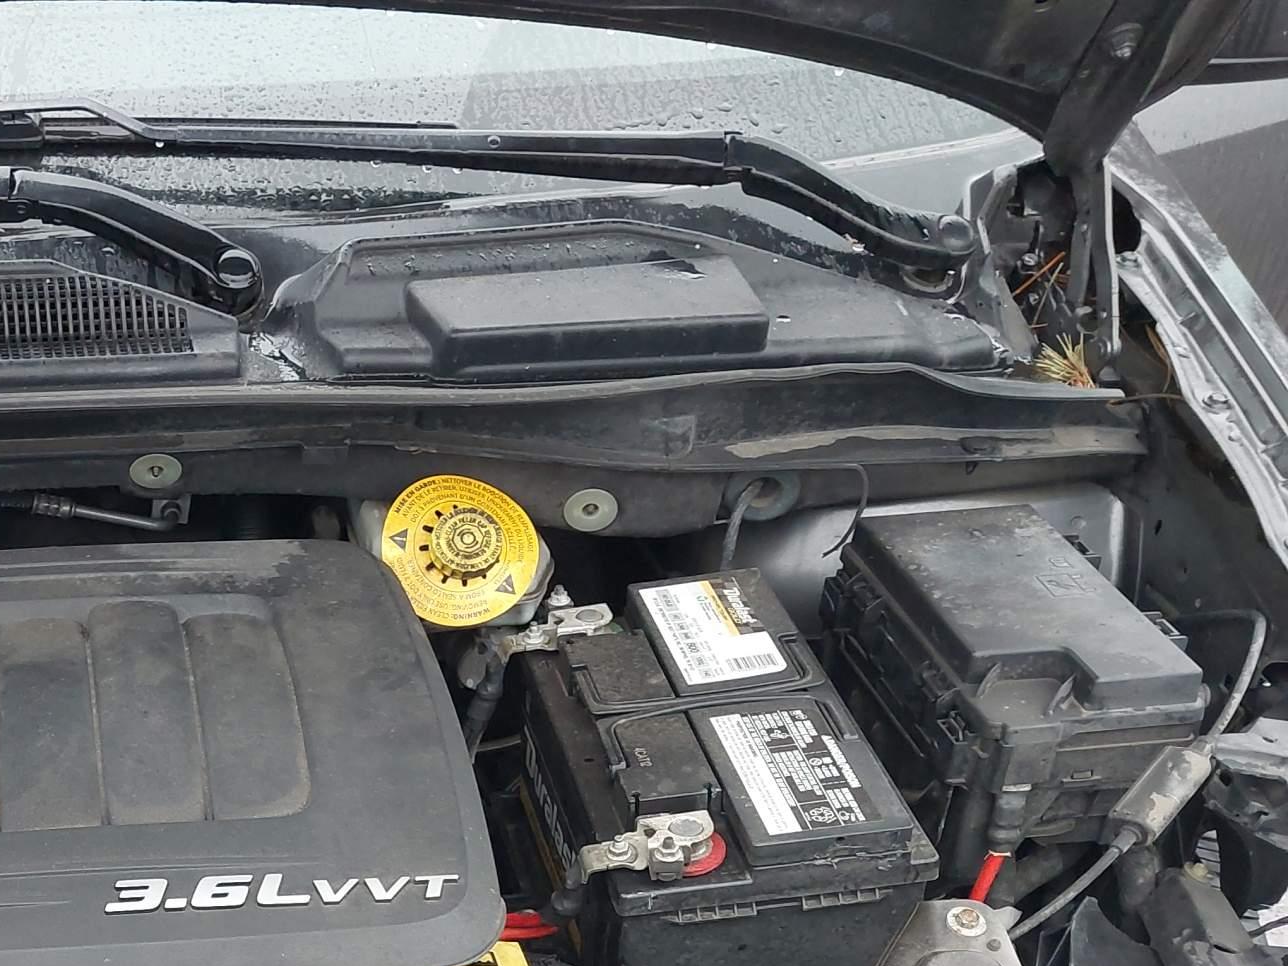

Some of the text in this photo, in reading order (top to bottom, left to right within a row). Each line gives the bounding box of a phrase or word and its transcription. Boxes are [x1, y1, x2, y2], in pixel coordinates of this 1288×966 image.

[402, 499, 417, 517] AVANT
[406, 489, 416, 499] EN
[411, 509, 421, 523] DOT
[723, 586, 758, 624] Duralast
[524, 724, 576, 872] Duralas
[104, 873, 460, 916] 3.6L VVT
